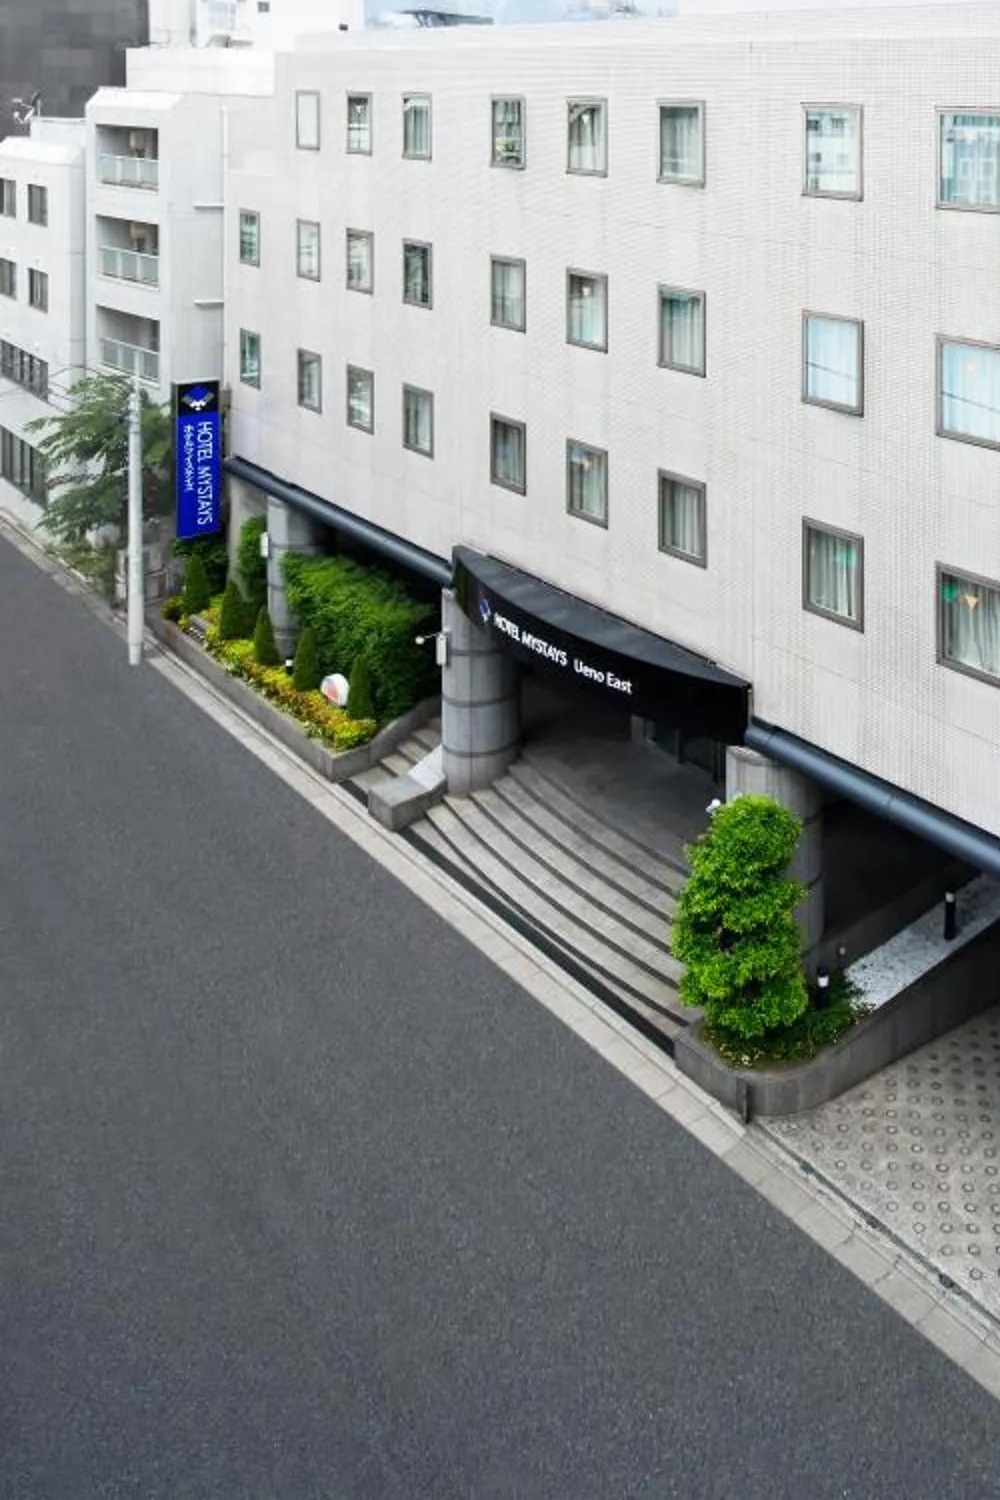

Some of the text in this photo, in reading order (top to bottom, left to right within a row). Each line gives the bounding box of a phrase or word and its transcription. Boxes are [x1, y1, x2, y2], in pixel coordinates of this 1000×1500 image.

[197, 421, 213, 525] HOTEL MYSTAYS
[493, 612, 633, 695] HOTEL MYSTAYS Ueno East
